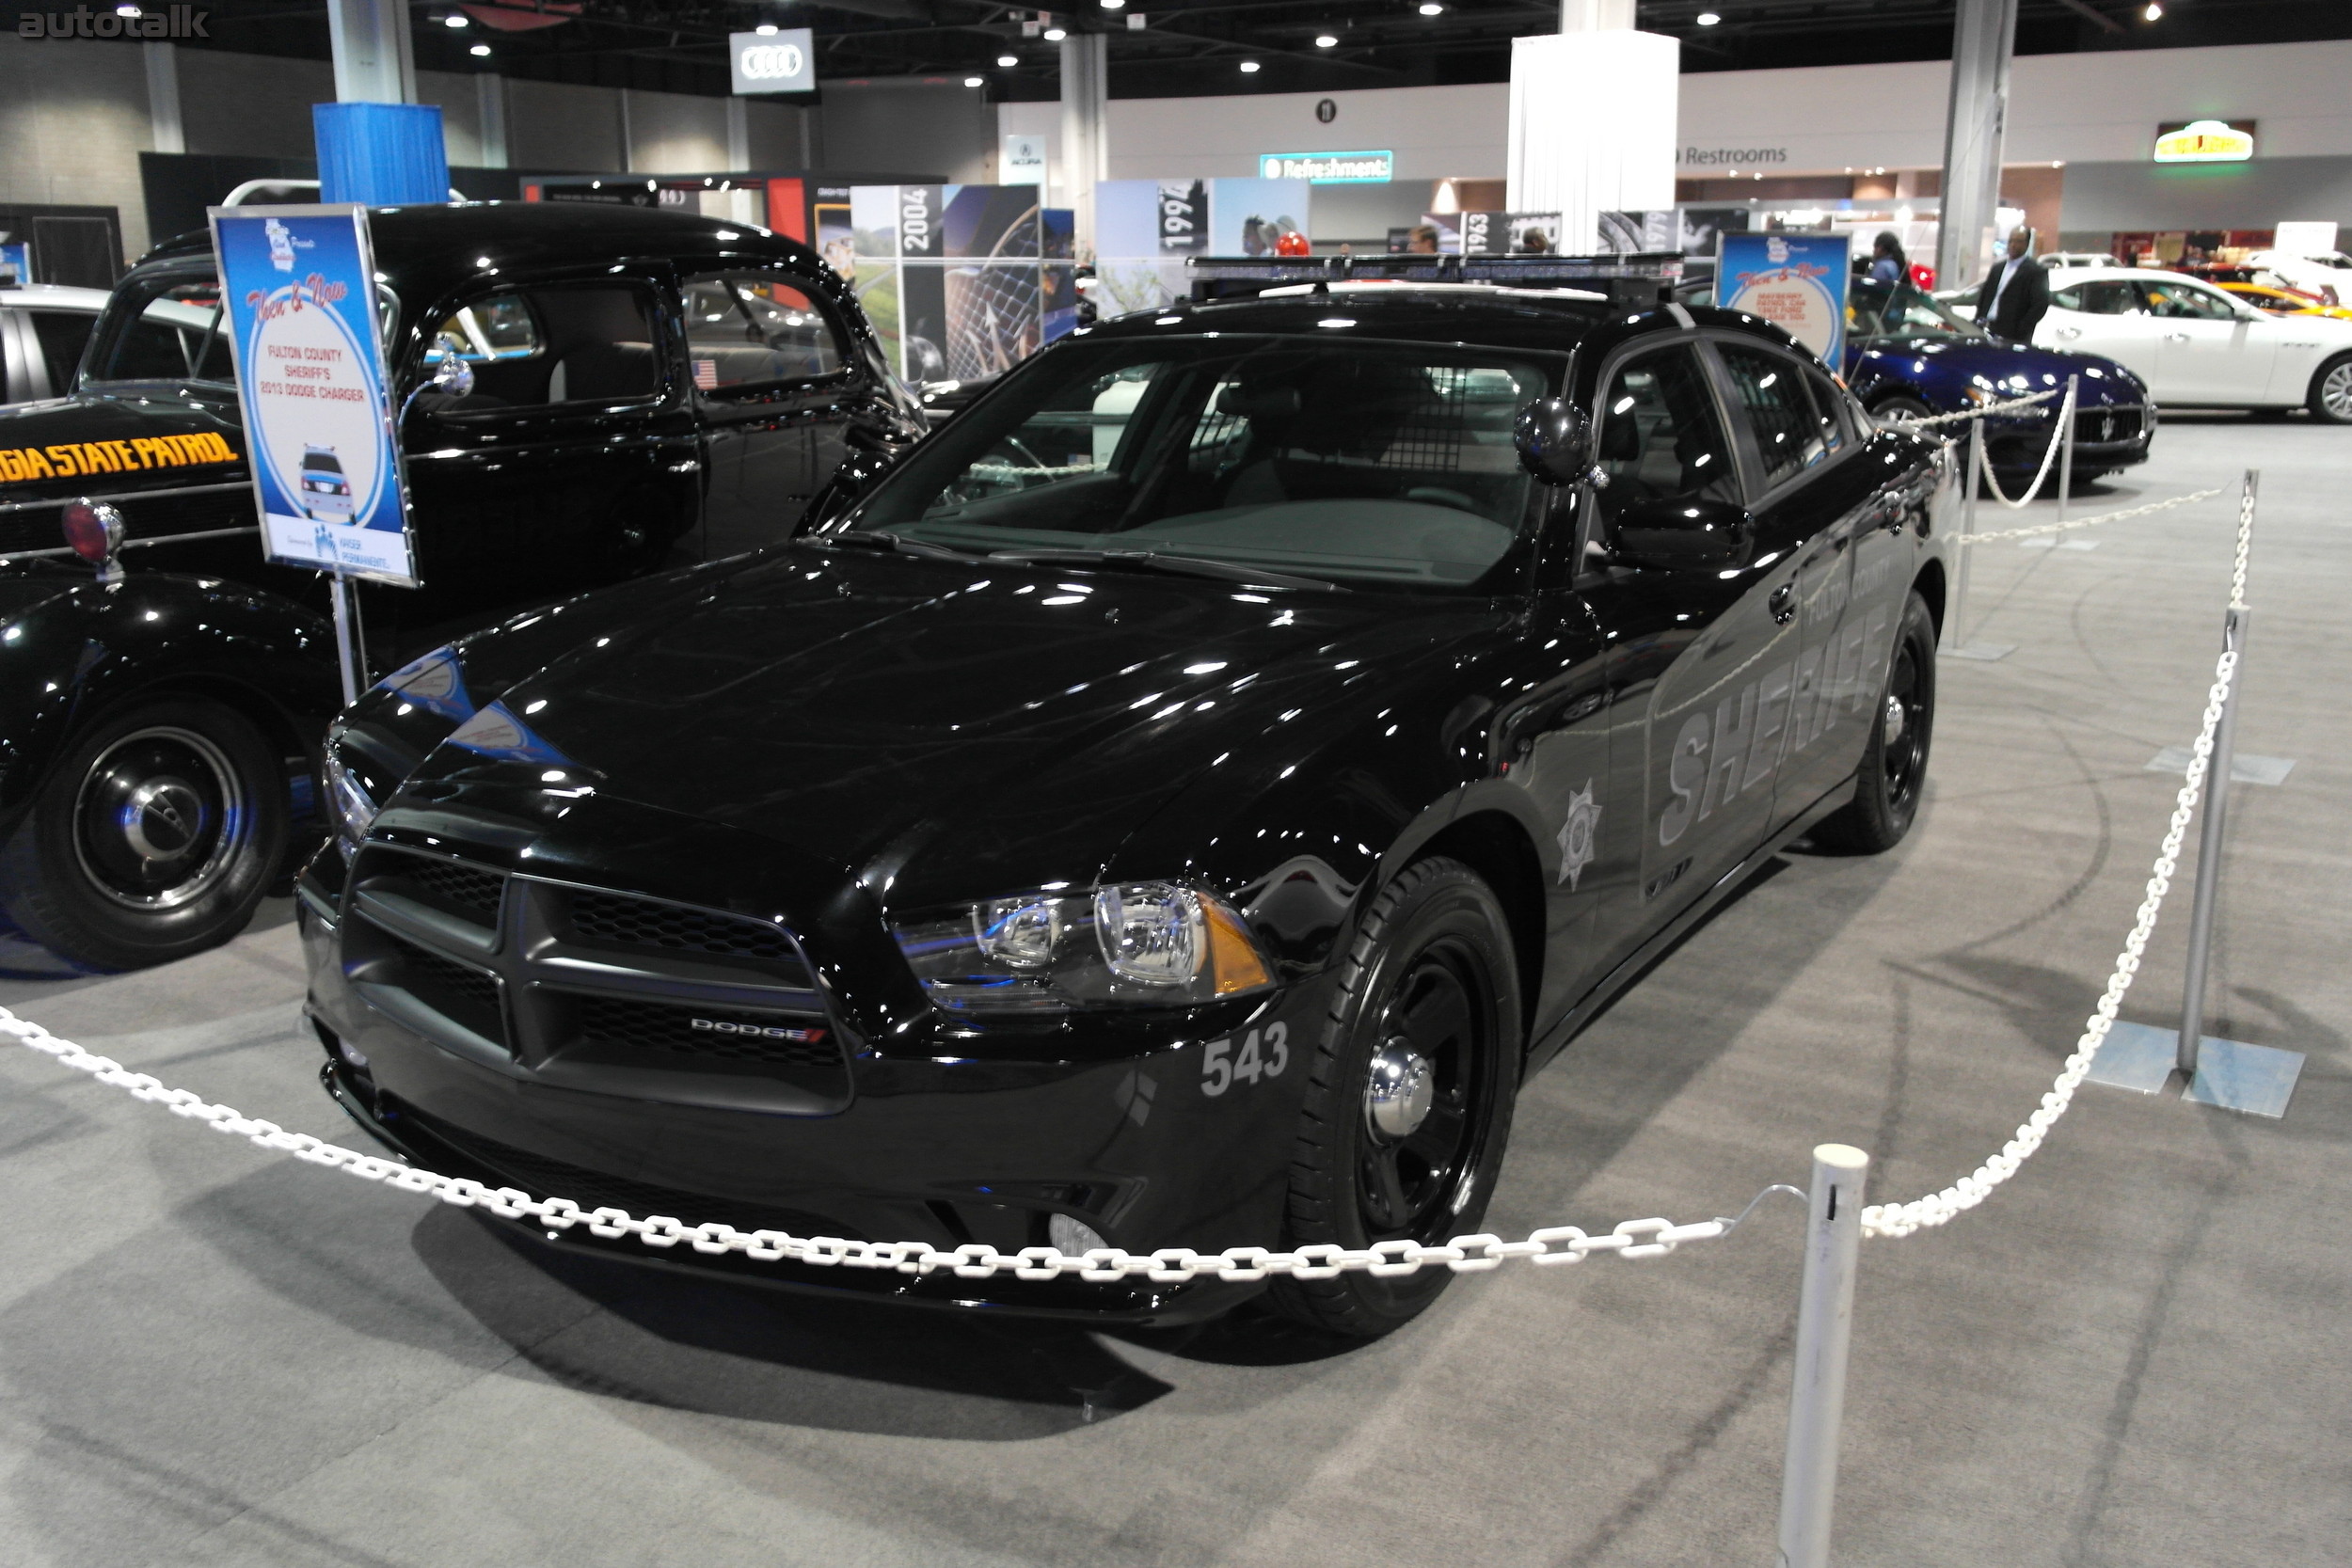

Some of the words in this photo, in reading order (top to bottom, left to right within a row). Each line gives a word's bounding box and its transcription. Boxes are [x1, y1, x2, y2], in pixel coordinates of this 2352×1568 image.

[1283, 158, 1389, 178] Refreshments
[1685, 147, 1787, 165] Restrooms
[902, 188, 930, 252] 2004
[1164, 182, 1193, 248] 1994
[1467, 214, 1490, 253] 1963
[1645, 212, 1668, 250] 1979
[1736, 271, 1771, 288] Then
[1778, 267, 1788, 281] &
[1796, 262, 1829, 279] Now
[246, 290, 285, 323] Then
[292, 280, 303, 312] &
[307, 273, 347, 308] Now
[268, 345, 301, 358] FULTON
[304, 347, 342, 361] COUNTY
[284, 364, 330, 380] SHERIFF'S
[260, 381, 282, 395] 2013
[285, 383, 316, 398] DODGE
[319, 386, 365, 402] CHARGER
[0, 448, 55, 483] GIA
[45, 439, 139, 478] STATE
[131, 432, 239, 469] PATROL
[1659, 604, 1887, 847] SHERIFF
[691, 1018, 808, 1041] DODGE
[1200, 1021, 1289, 1097] 543
